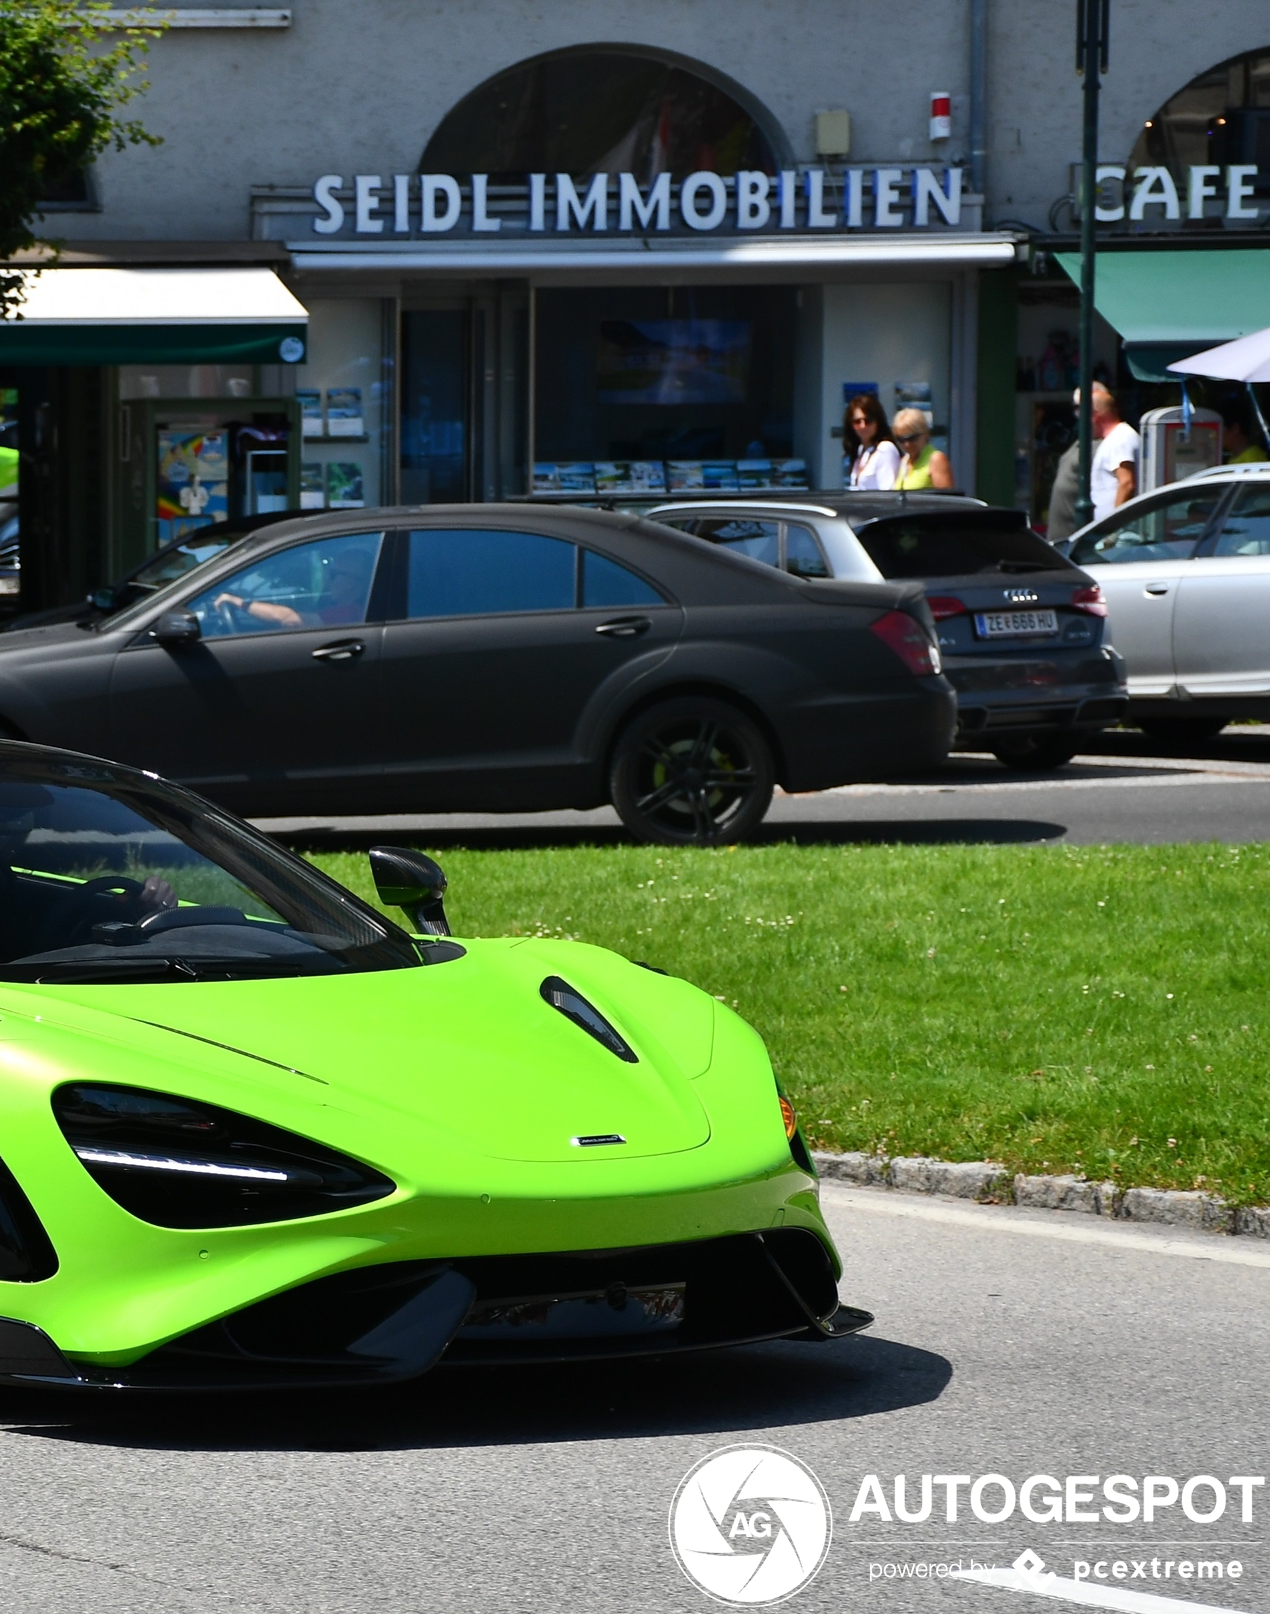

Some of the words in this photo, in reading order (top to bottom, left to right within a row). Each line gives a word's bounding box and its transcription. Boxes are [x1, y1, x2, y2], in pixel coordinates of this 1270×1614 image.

[313, 173, 501, 234] SEIDL
[529, 168, 963, 232] IMMOBILIEN
[1093, 164, 1260, 222] CAFE
[988, 616, 1004, 631] ZE
[1038, 611, 1054, 629] HU
